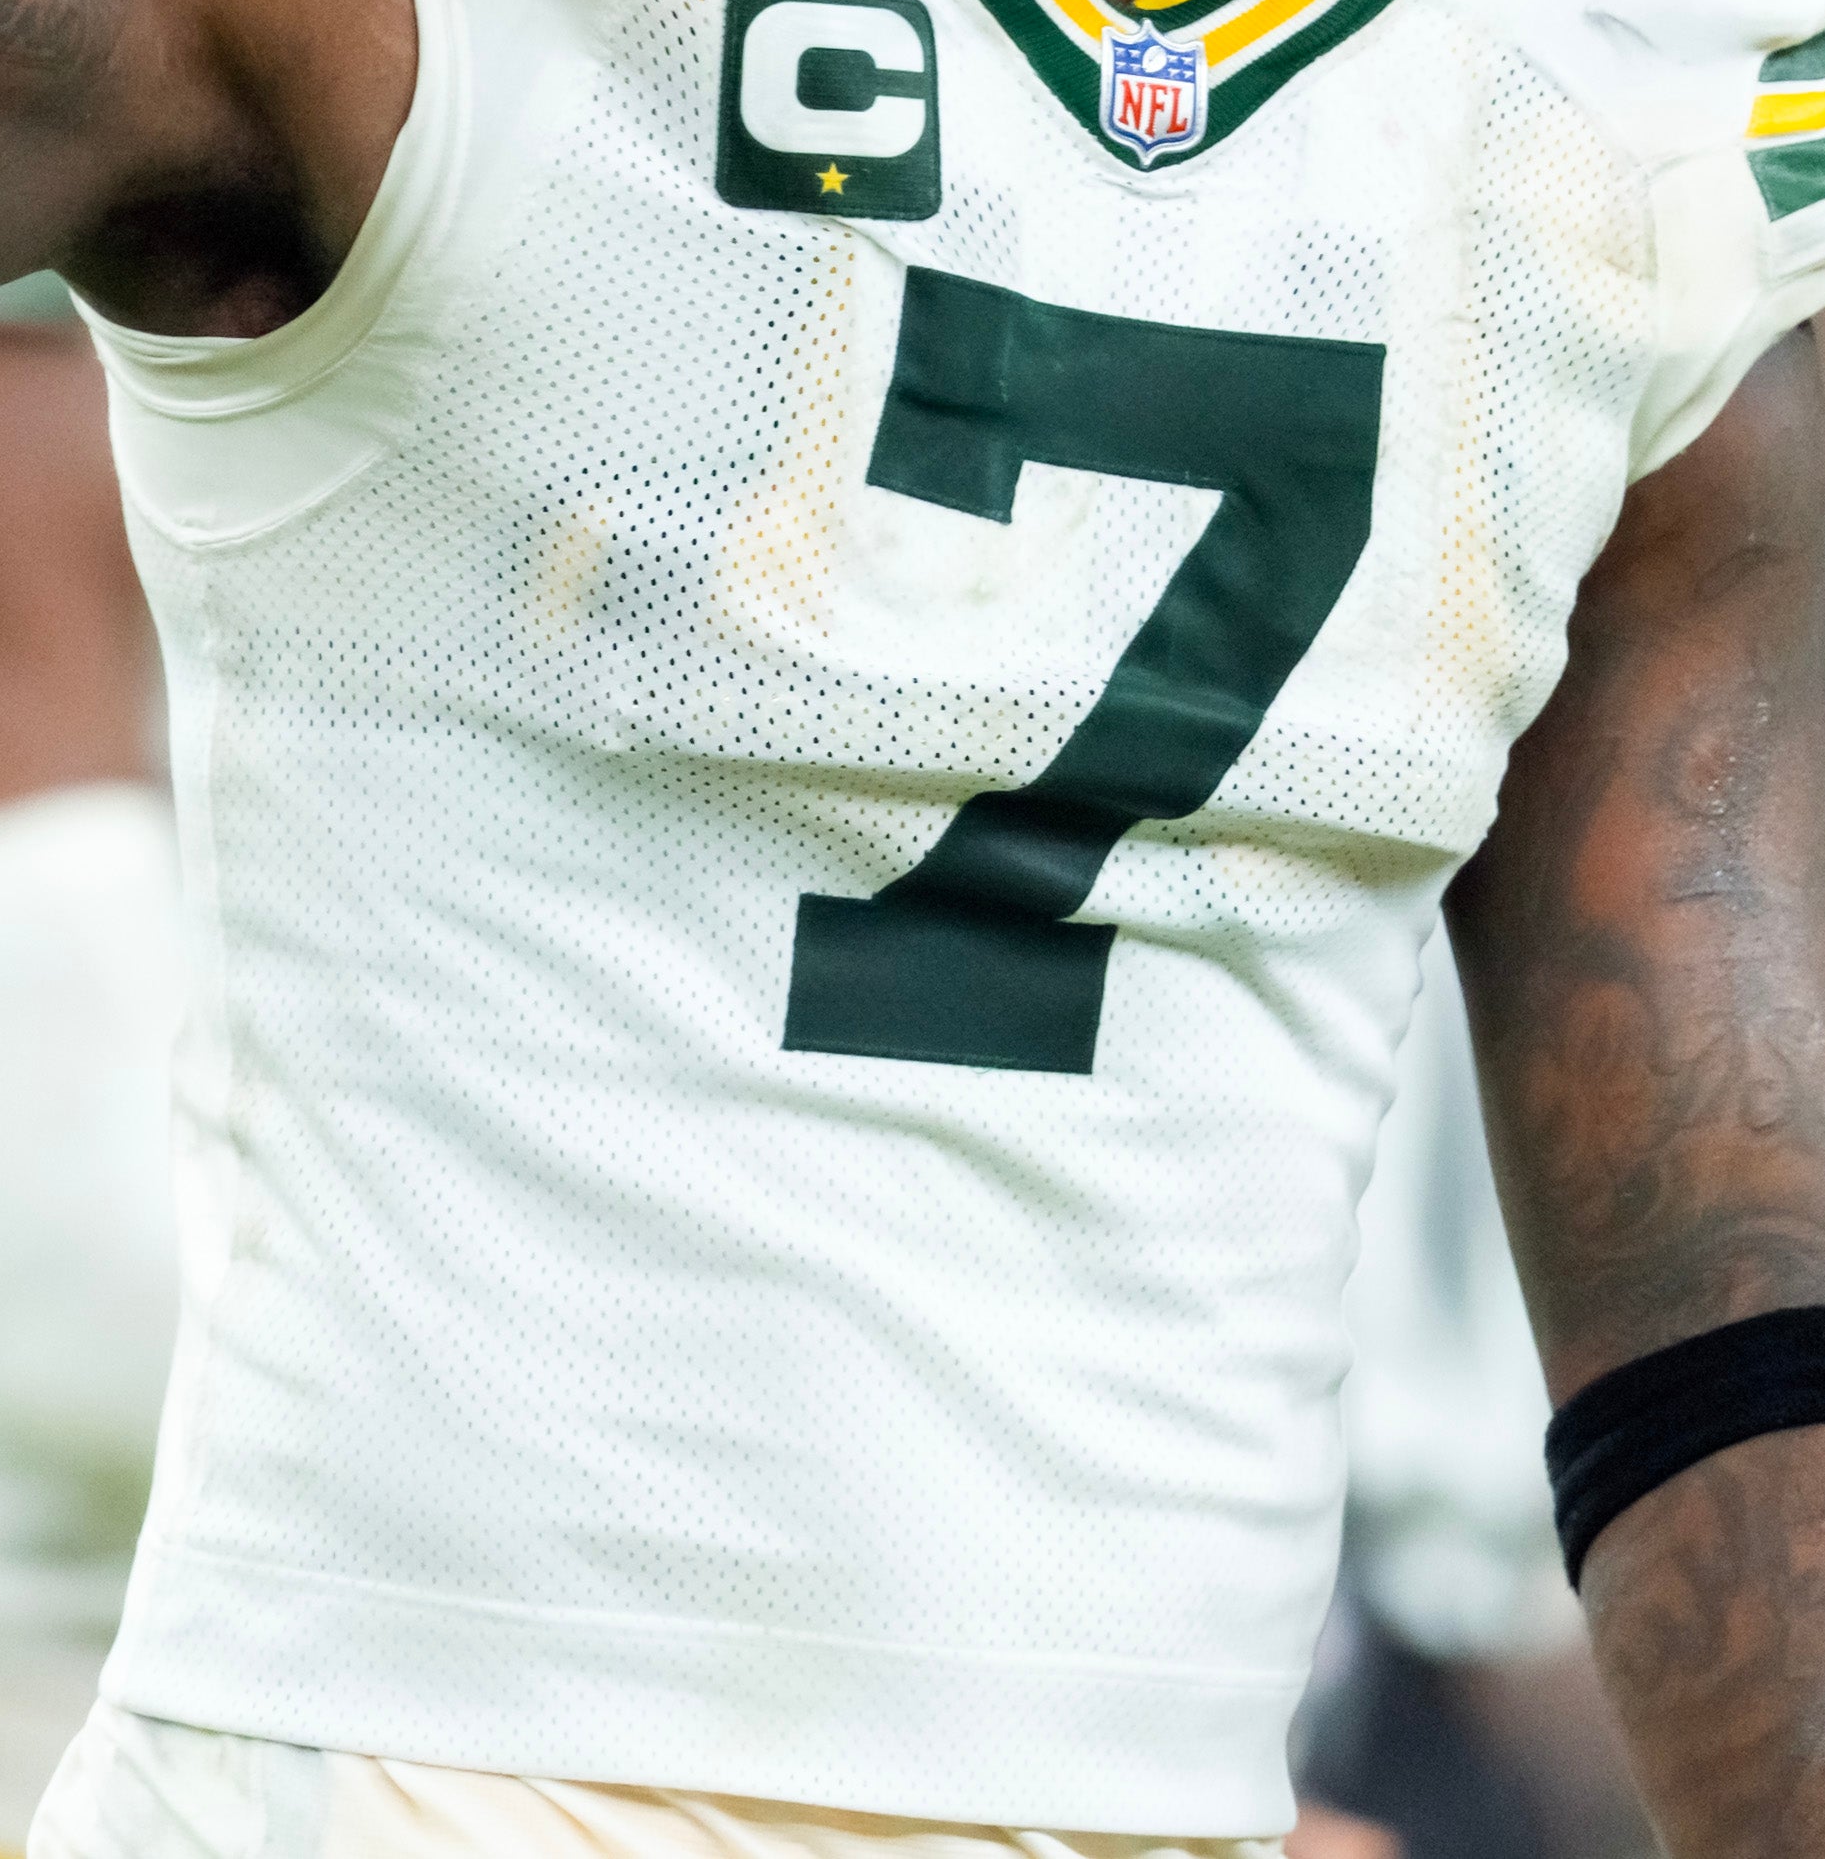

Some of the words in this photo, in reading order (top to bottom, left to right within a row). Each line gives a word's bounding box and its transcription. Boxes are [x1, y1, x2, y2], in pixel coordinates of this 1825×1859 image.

[739, 0, 926, 159] C
[1117, 78, 1189, 139] NFL
[781, 264, 1387, 1075] 7
